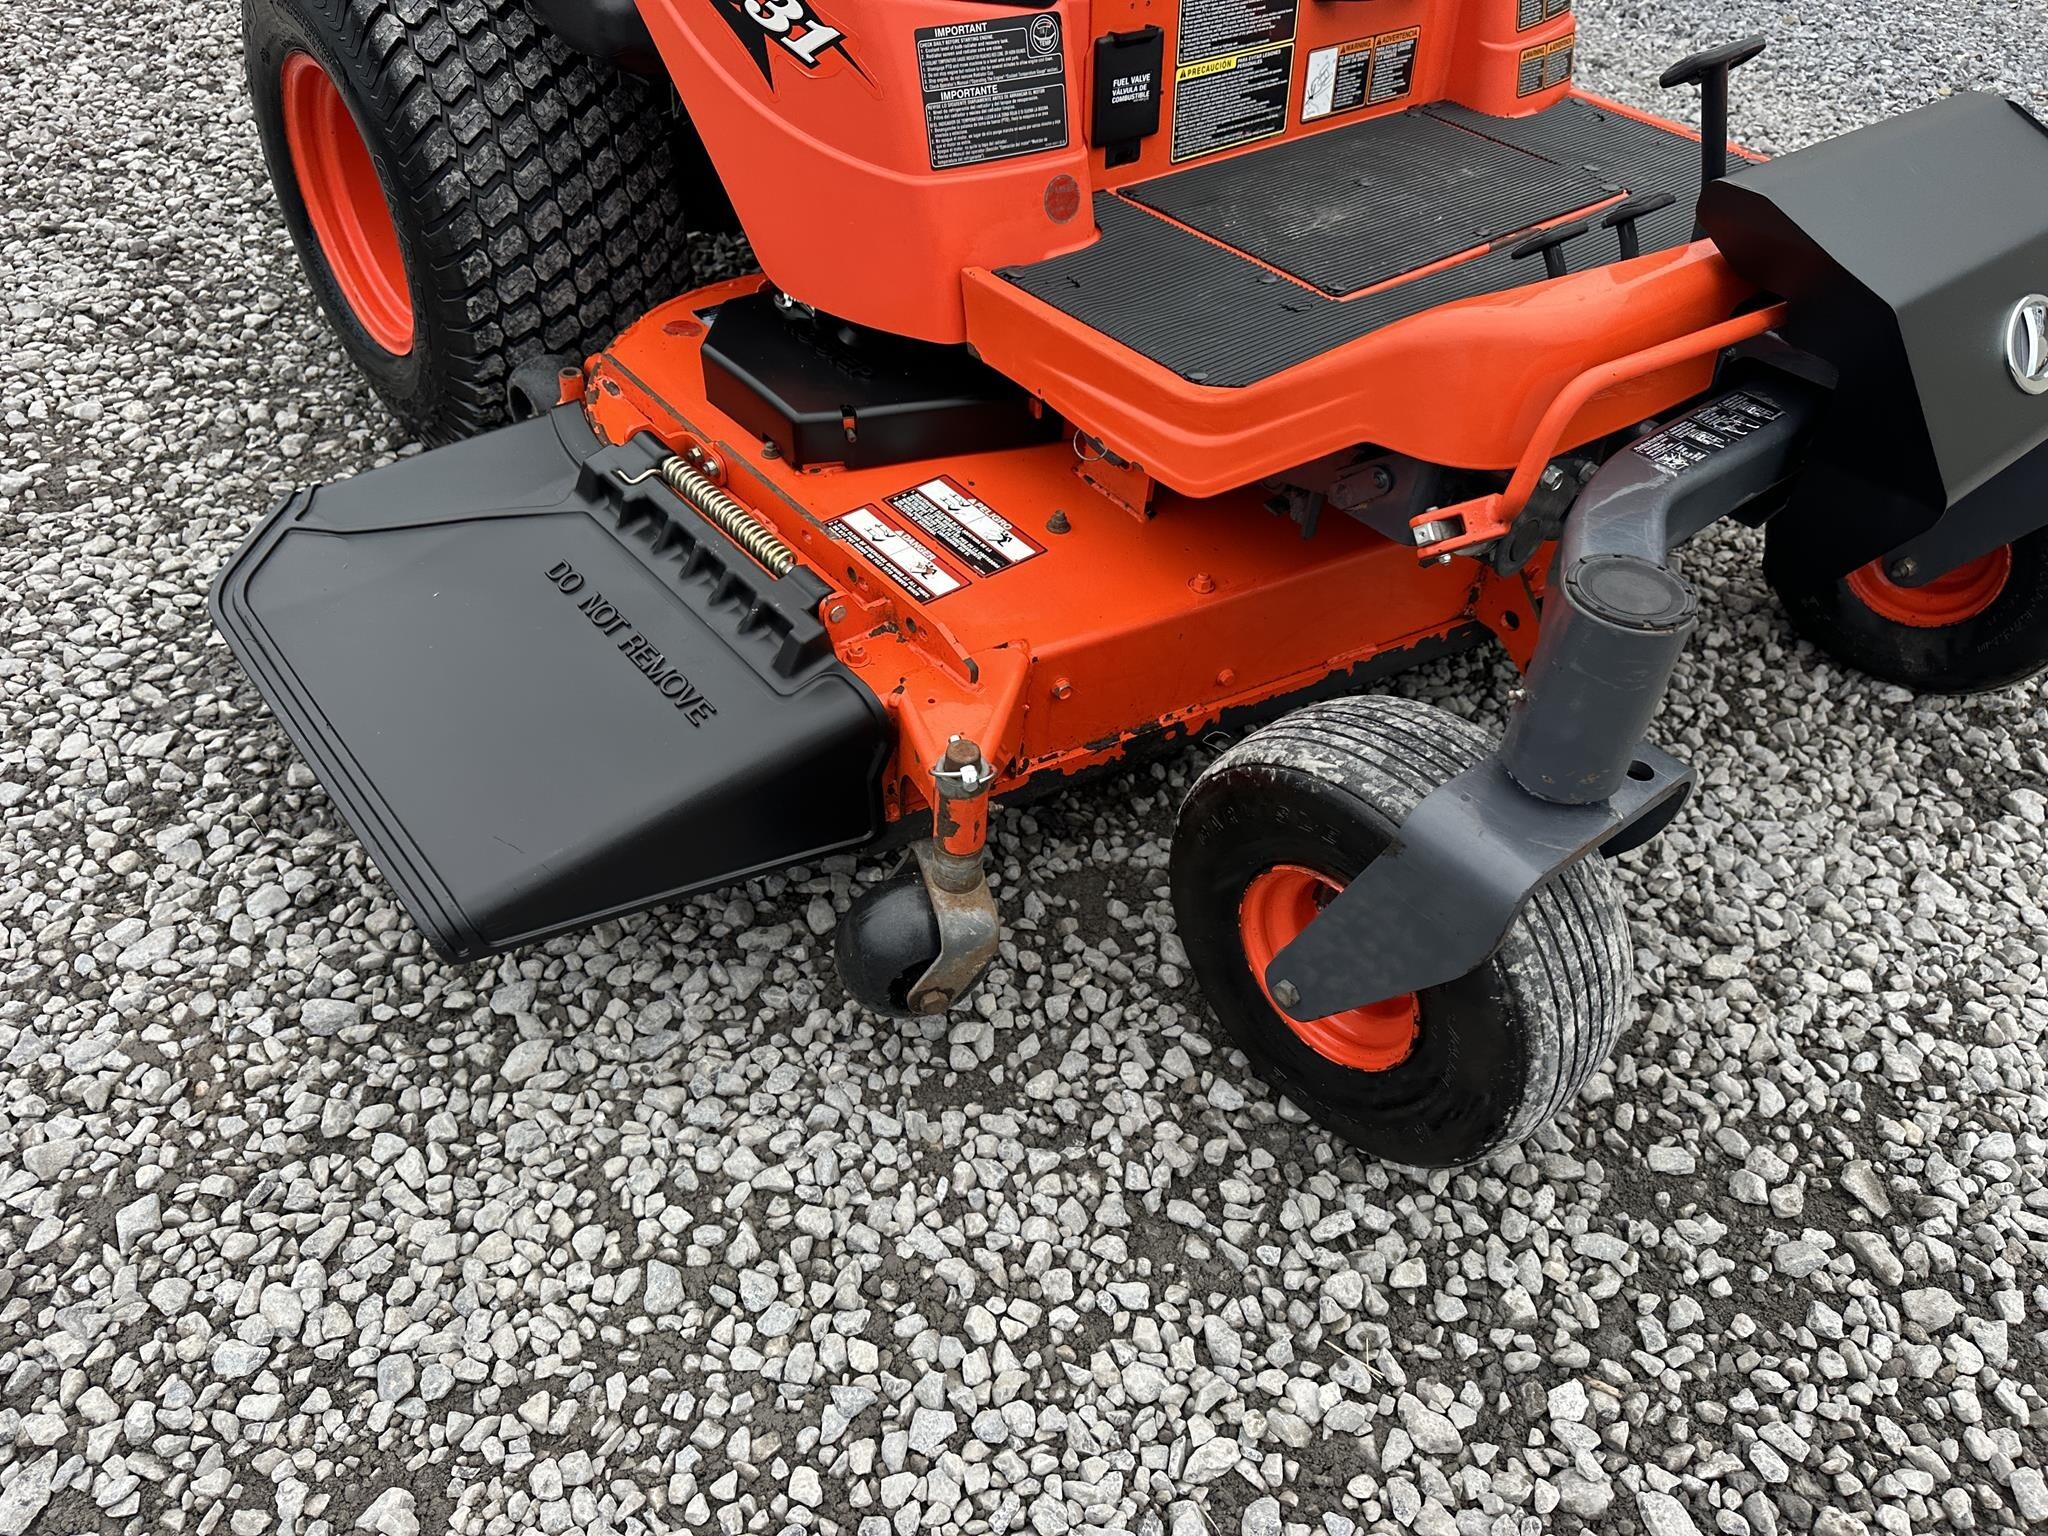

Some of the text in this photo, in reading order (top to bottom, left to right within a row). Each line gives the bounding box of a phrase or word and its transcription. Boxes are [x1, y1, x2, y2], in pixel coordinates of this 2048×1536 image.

[934, 23, 988, 38] IMPORTANT
[1345, 40, 1371, 51] WARNING
[1187, 59, 1232, 77] PRECAUCIÓN
[1113, 73, 1151, 88] FUEL VALVE
[940, 84, 999, 101] IMPORTANTE
[1111, 90, 1150, 104] COMBUSTIBLE
[1112, 83, 1148, 97] VÁLVULA DE
[974, 501, 1013, 531] PELIGRO
[901, 533, 937, 562] DANGER
[544, 558, 718, 728] DO NOT REMOVE
